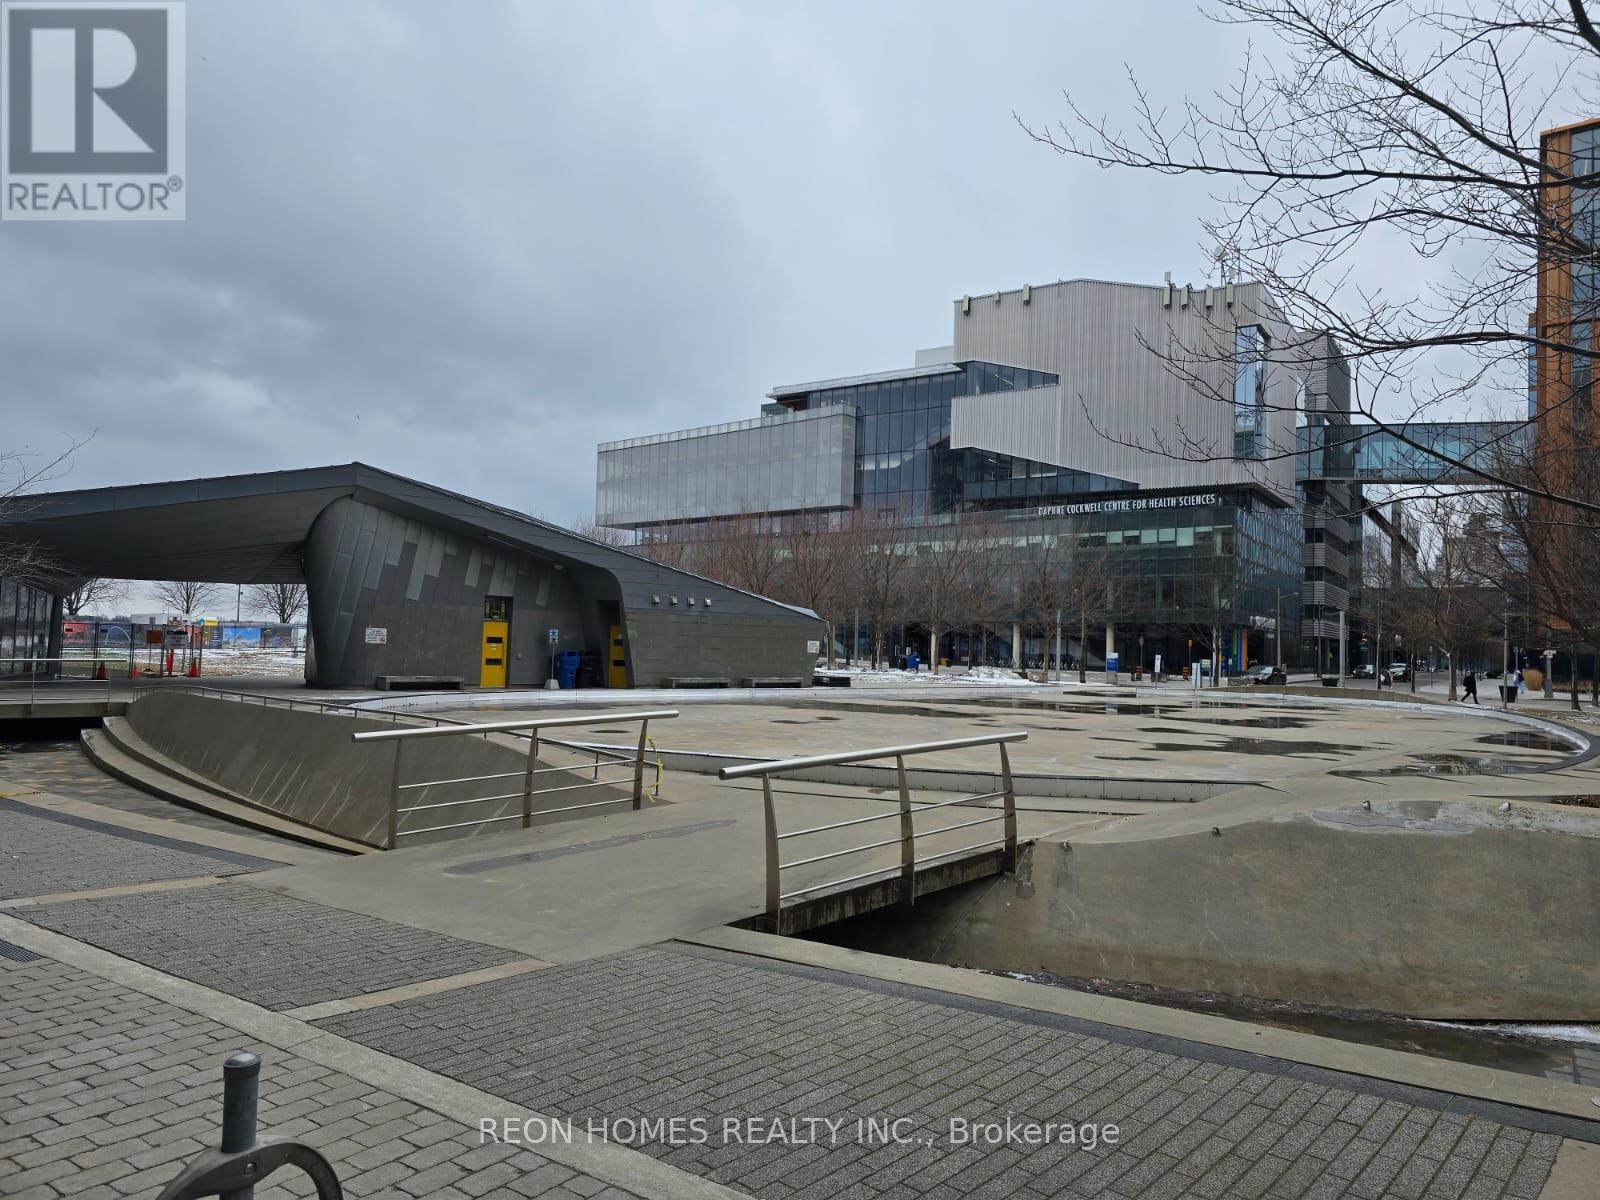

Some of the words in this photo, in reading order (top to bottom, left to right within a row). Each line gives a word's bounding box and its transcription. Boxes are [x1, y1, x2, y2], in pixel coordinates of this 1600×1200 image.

[1038, 505, 1065, 516] DAPHNE
[1066, 502, 1102, 514] COCKWELL
[1104, 499, 1130, 511] CENTRE
[1132, 499, 1147, 510] FOR
[1149, 496, 1176, 509] HEALTH
[1179, 494, 1215, 506] SCIENCES
